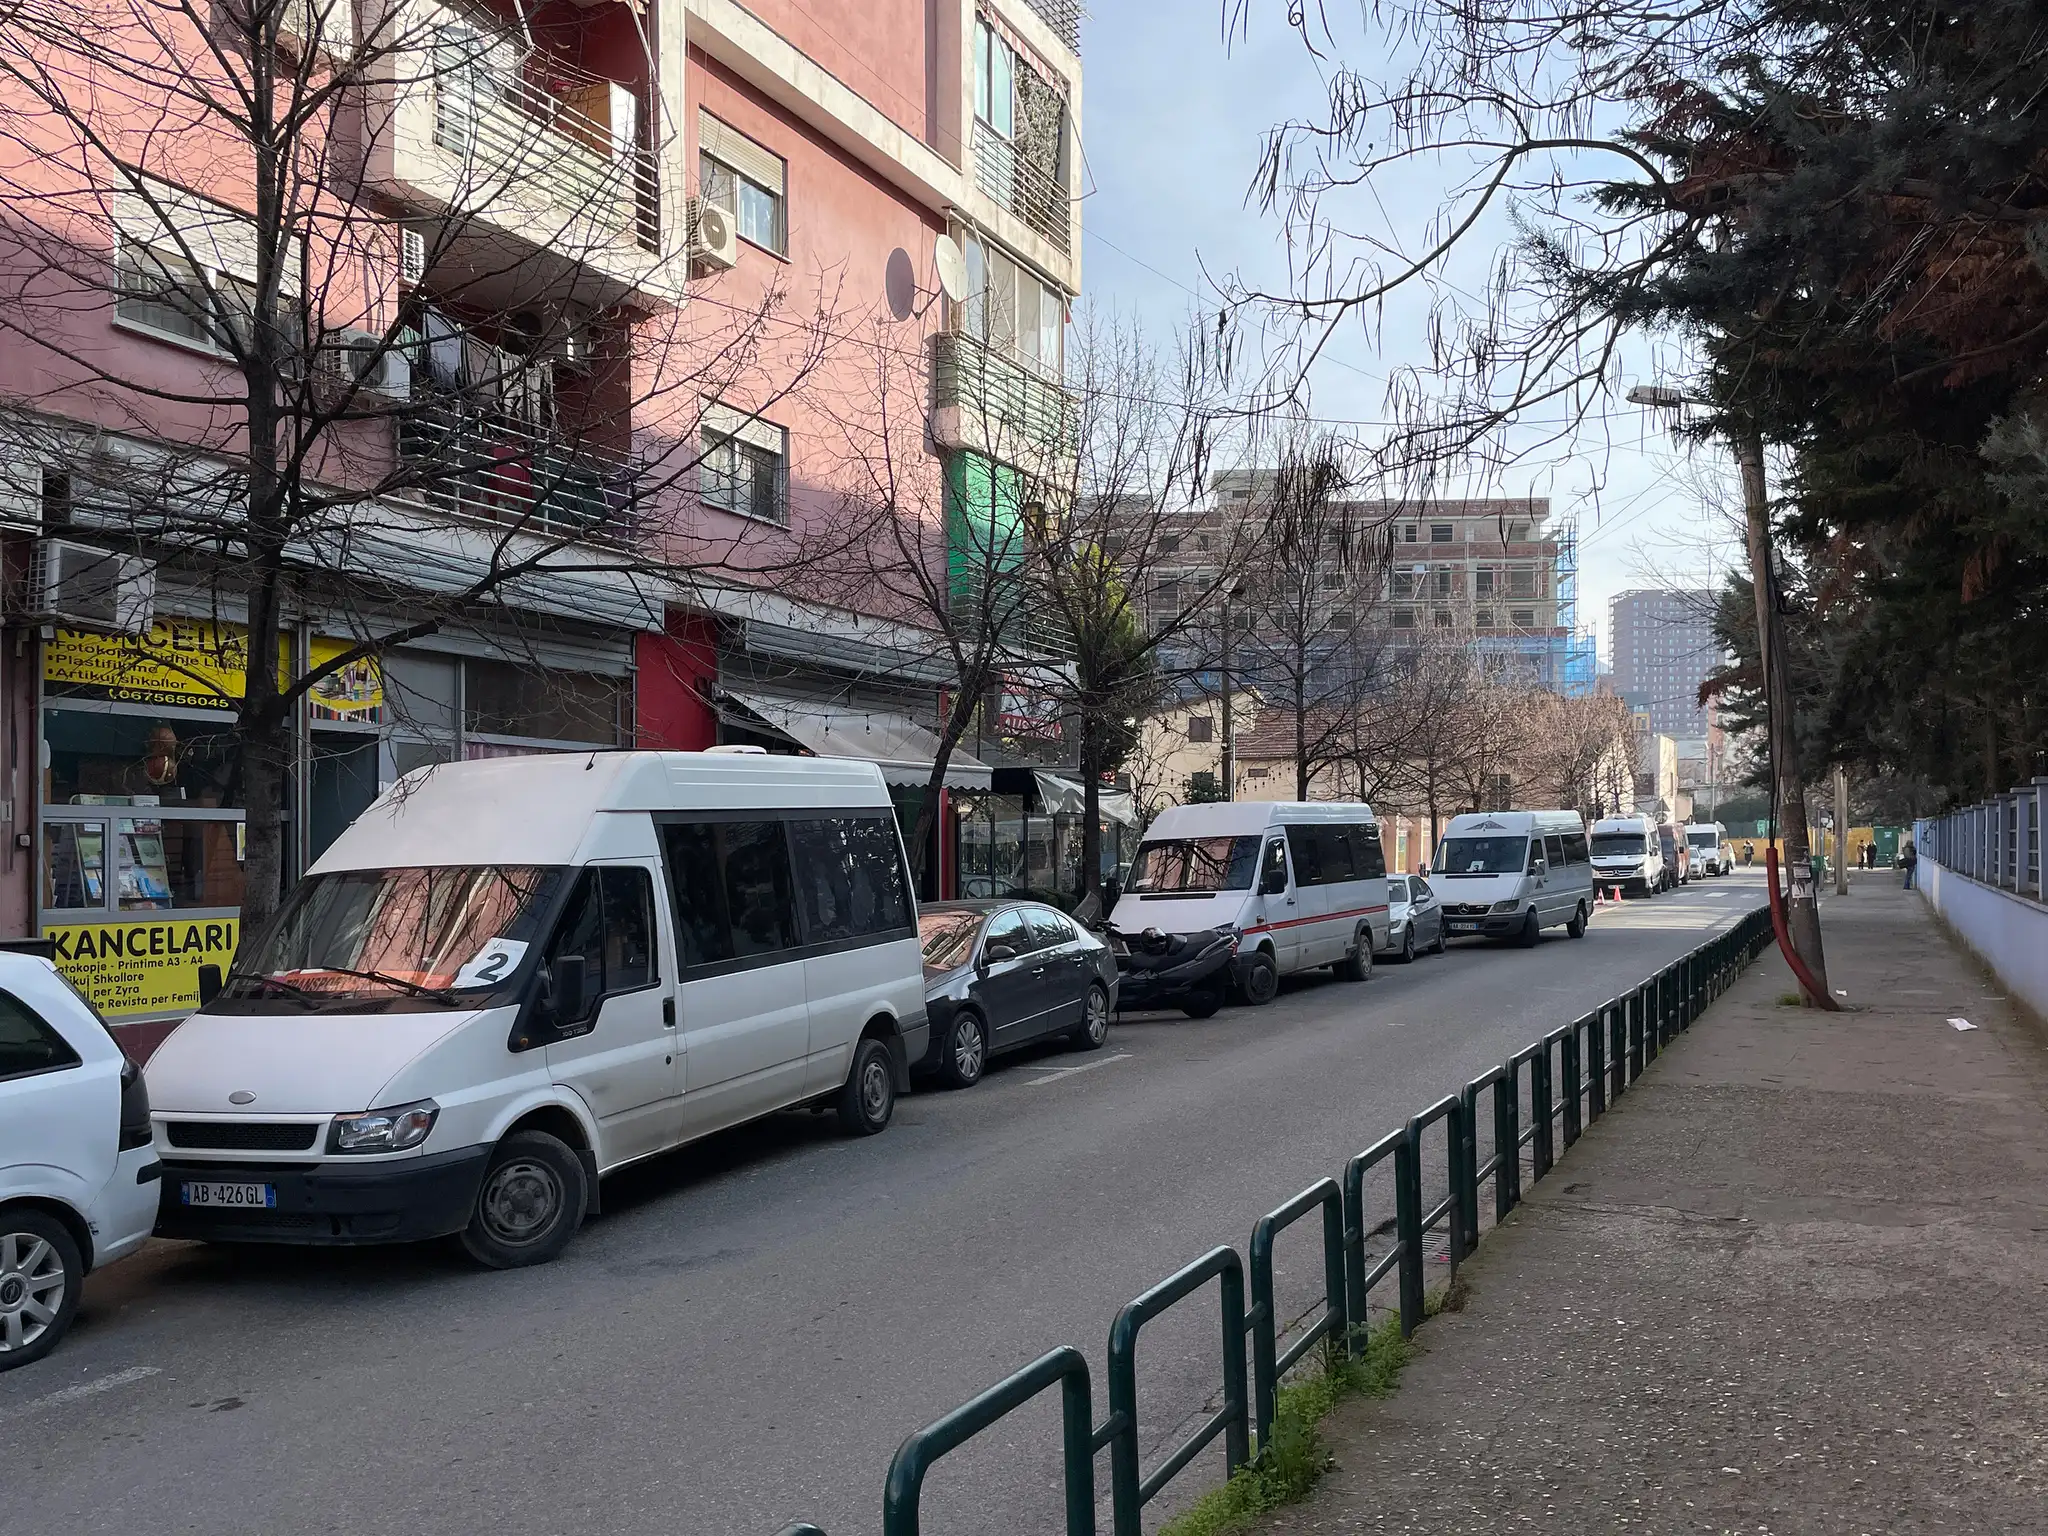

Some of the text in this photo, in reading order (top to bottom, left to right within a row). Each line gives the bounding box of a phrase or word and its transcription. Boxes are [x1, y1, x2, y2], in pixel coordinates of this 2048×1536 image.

[56, 668, 116, 684] Artikuj
[119, 689, 229, 708] 0675656045
[50, 924, 231, 961] KANCELARI
[56, 961, 106, 975] otokopje
[118, 958, 163, 971] Printime
[167, 955, 180, 967] A3
[190, 955, 203, 965] A4
[475, 953, 508, 982] 2
[94, 973, 144, 985] Shkollore
[91, 991, 199, 1010] he Revista per Femij
[94, 988, 110, 999] per
[116, 985, 139, 997] Zyra
